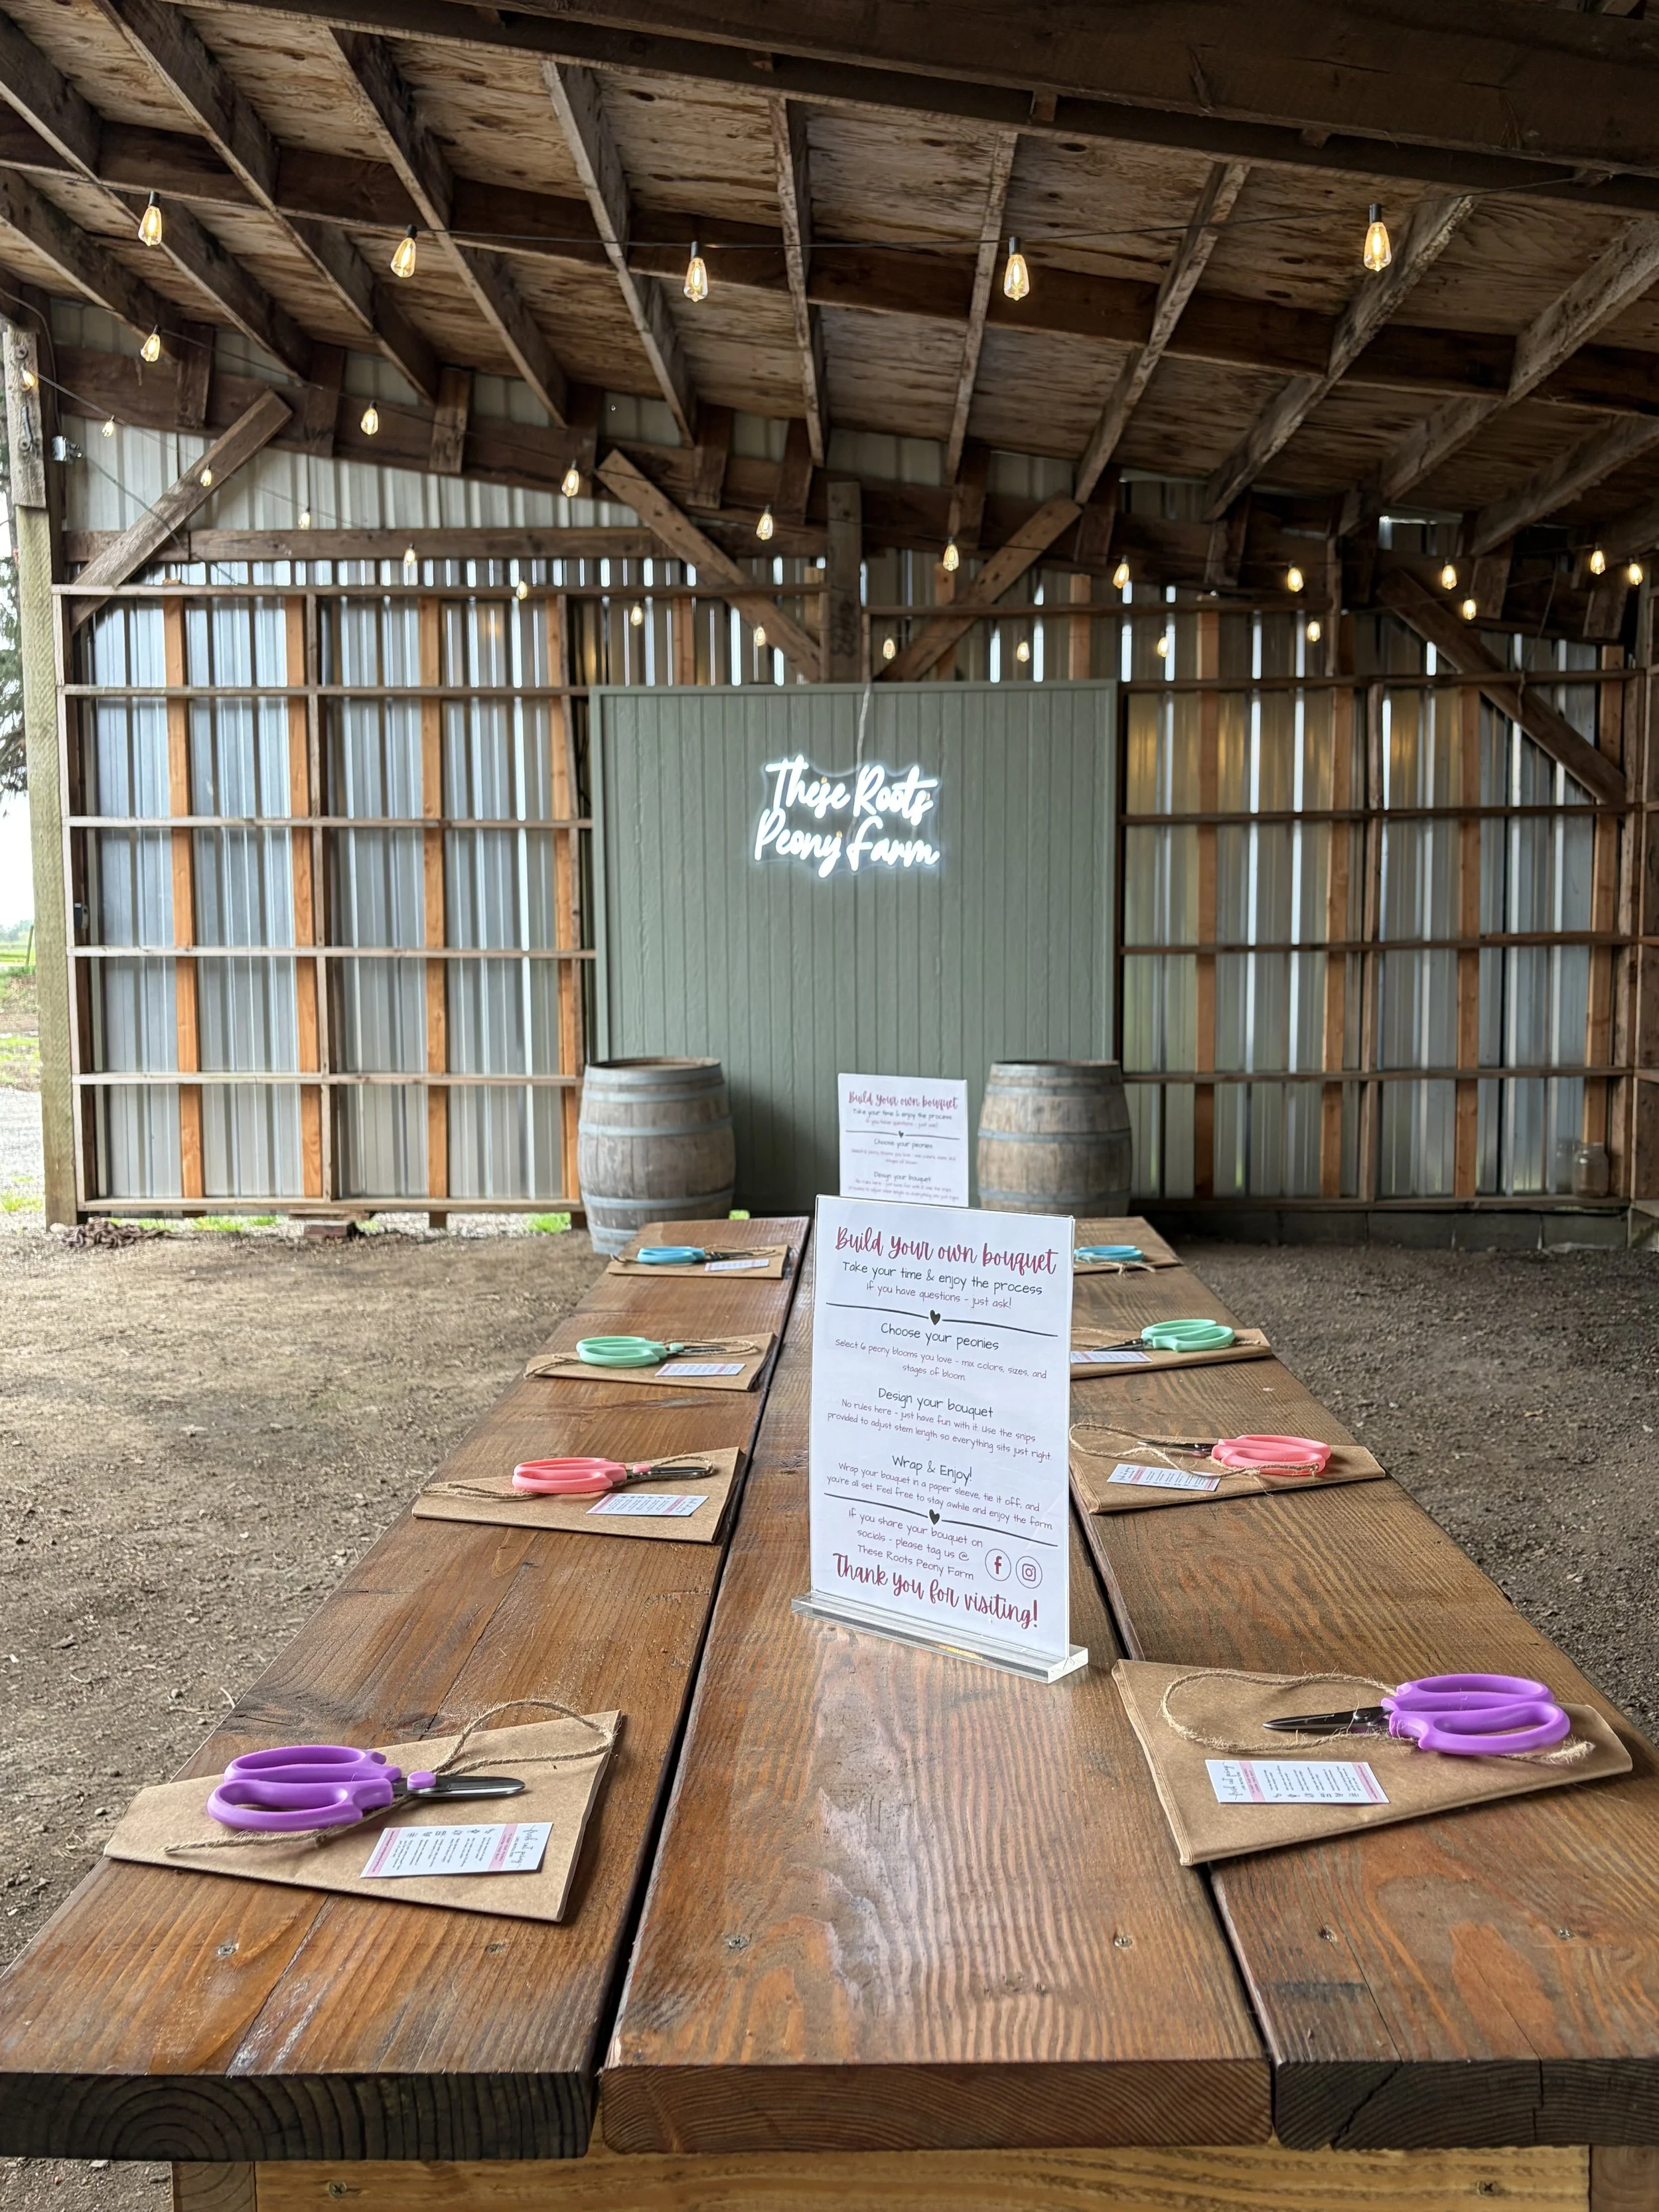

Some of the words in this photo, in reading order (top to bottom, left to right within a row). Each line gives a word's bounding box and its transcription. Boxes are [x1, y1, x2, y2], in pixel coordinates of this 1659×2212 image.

[765, 754, 850, 819] These
[853, 765, 938, 826] Roots
[755, 808, 843, 878] Peony
[846, 815, 940, 871] Farm
[849, 1090, 874, 1106] Build
[901, 1096, 920, 1107] own
[922, 1095, 959, 1112] bouquet
[908, 1174, 932, 1184] bouquet
[835, 1226, 884, 1257] Build
[938, 1244, 978, 1264] own
[983, 1243, 1059, 1277] bouquet
[843, 1261, 868, 1274] Take
[872, 1267, 897, 1281] your
[901, 1267, 922, 1280] time
[926, 1269, 935, 1282] &
[939, 1275, 968, 1292] enjoy
[972, 1276, 989, 1289] the
[994, 1282, 1043, 1295] process
[867, 1280, 875, 1291] If
[877, 1286, 893, 1297] you
[896, 1286, 916, 1297] have
[919, 1291, 961, 1303] questions
[971, 1297, 989, 1309] just
[993, 1297, 1012, 1309] ask!
[881, 1323, 921, 1339] Choose
[925, 1333, 952, 1347] your
[957, 1337, 999, 1351] peonies
[835, 1339, 859, 1349] Select
[869, 1346, 891, 1358] peony
[893, 1347, 918, 1359] blooms
[920, 1355, 934, 1364] you
[937, 1354, 952, 1364] love
[1033, 1370, 1047, 1379] and
[902, 1364, 927, 1377] stages
[930, 1367, 940, 1376] of
[942, 1368, 966, 1381] bloom
[842, 1399, 852, 1408] No
[854, 1403, 872, 1412] rules
[875, 1405, 892, 1416] here
[900, 1412, 914, 1422] just
[917, 1412, 934, 1424] have
[937, 1415, 951, 1427] fun
[954, 1421, 970, 1430] with
[982, 1426, 997, 1435] Use
[999, 1428, 1013, 1438] the
[1016, 1434, 1036, 1445] snips
[879, 1388, 912, 1409] Design
[917, 1398, 944, 1412] your
[948, 1398, 994, 1421] bouquet
[828, 1413, 859, 1423] provided
[871, 1419, 893, 1432] adjust
[895, 1424, 913, 1434] stem
[916, 1427, 938, 1441] length
[952, 1436, 994, 1454] everything
[997, 1443, 1011, 1453] sits
[1013, 1447, 1029, 1457] just
[839, 1463, 859, 1477] Wrap
[861, 1469, 879, 1479] your
[881, 1471, 910, 1485] bouquet
[913, 1478, 919, 1487] in
[929, 1483, 952, 1495] paper
[983, 1493, 993, 1502] tie
[997, 1495, 1002, 1504] it
[1025, 1503, 1040, 1512] and
[892, 1455, 923, 1476] Wrap
[927, 1460, 936, 1473] &
[940, 1465, 972, 1487] Enjoy!
[877, 1485, 893, 1495] Feel
[895, 1487, 914, 1499] free
[916, 1493, 925, 1502] to
[927, 1496, 944, 1511] stay
[946, 1501, 970, 1512] awhile
[973, 1507, 987, 1515] and
[989, 1511, 1011, 1524] enjoy
[1013, 1514, 1027, 1524] the
[1029, 1516, 1052, 1530] farm
[849, 1508, 857, 1518] If
[859, 1514, 875, 1525] you
[878, 1516, 903, 1530] share
[906, 1525, 928, 1536] your
[932, 1527, 968, 1546] bouquet
[972, 1540, 983, 1548] on
[857, 1530, 886, 1542] socials
[896, 1537, 923, 1551] please
[926, 1544, 942, 1561] tag
[944, 1550, 955, 1559] us
[959, 1552, 970, 1562] @
[857, 1544, 883, 1558] These
[887, 1551, 913, 1566] Roots
[916, 1559, 944, 1578] Peony
[948, 1566, 974, 1581] Farm
[833, 1553, 889, 1587] Thank
[893, 1572, 925, 1600] you
[930, 1579, 960, 1608] for
[965, 1593, 1038, 1630] visiting!
